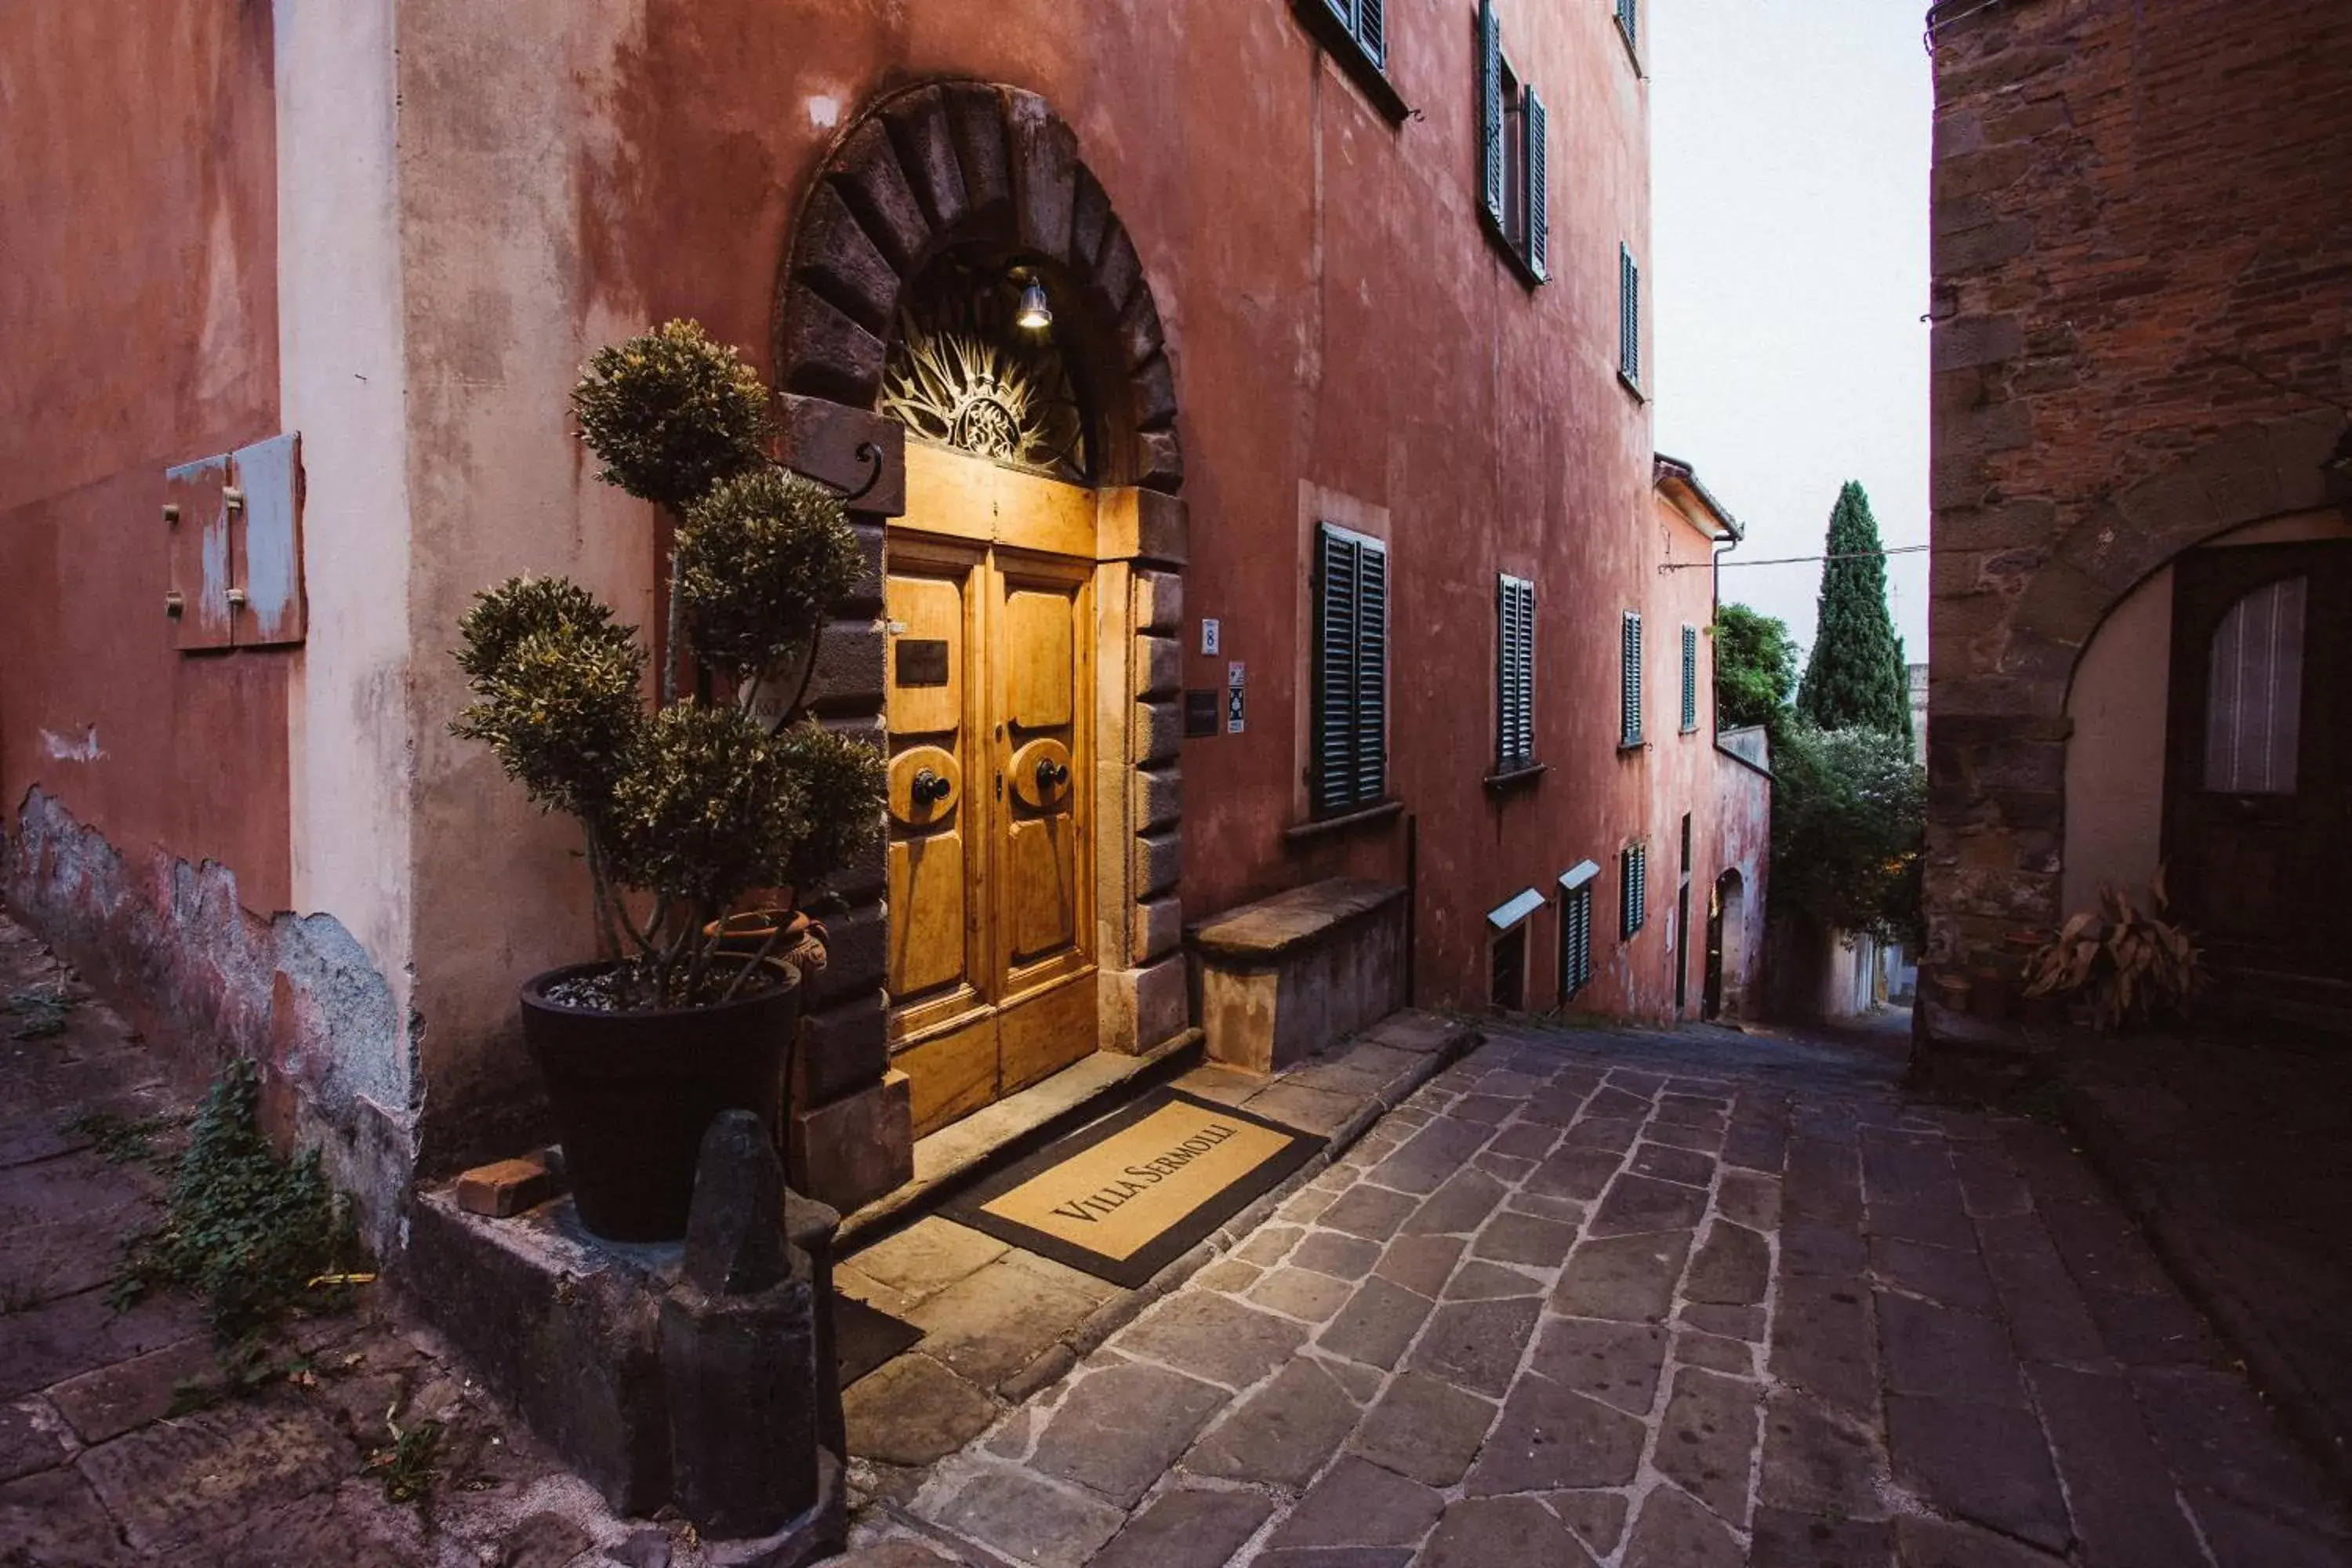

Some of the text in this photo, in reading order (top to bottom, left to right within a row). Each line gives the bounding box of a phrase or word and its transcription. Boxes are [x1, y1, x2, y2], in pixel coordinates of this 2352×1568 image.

[1207, 630, 1214, 647] 8
[1051, 1123, 1238, 1222] VILLA SERMOLLI
